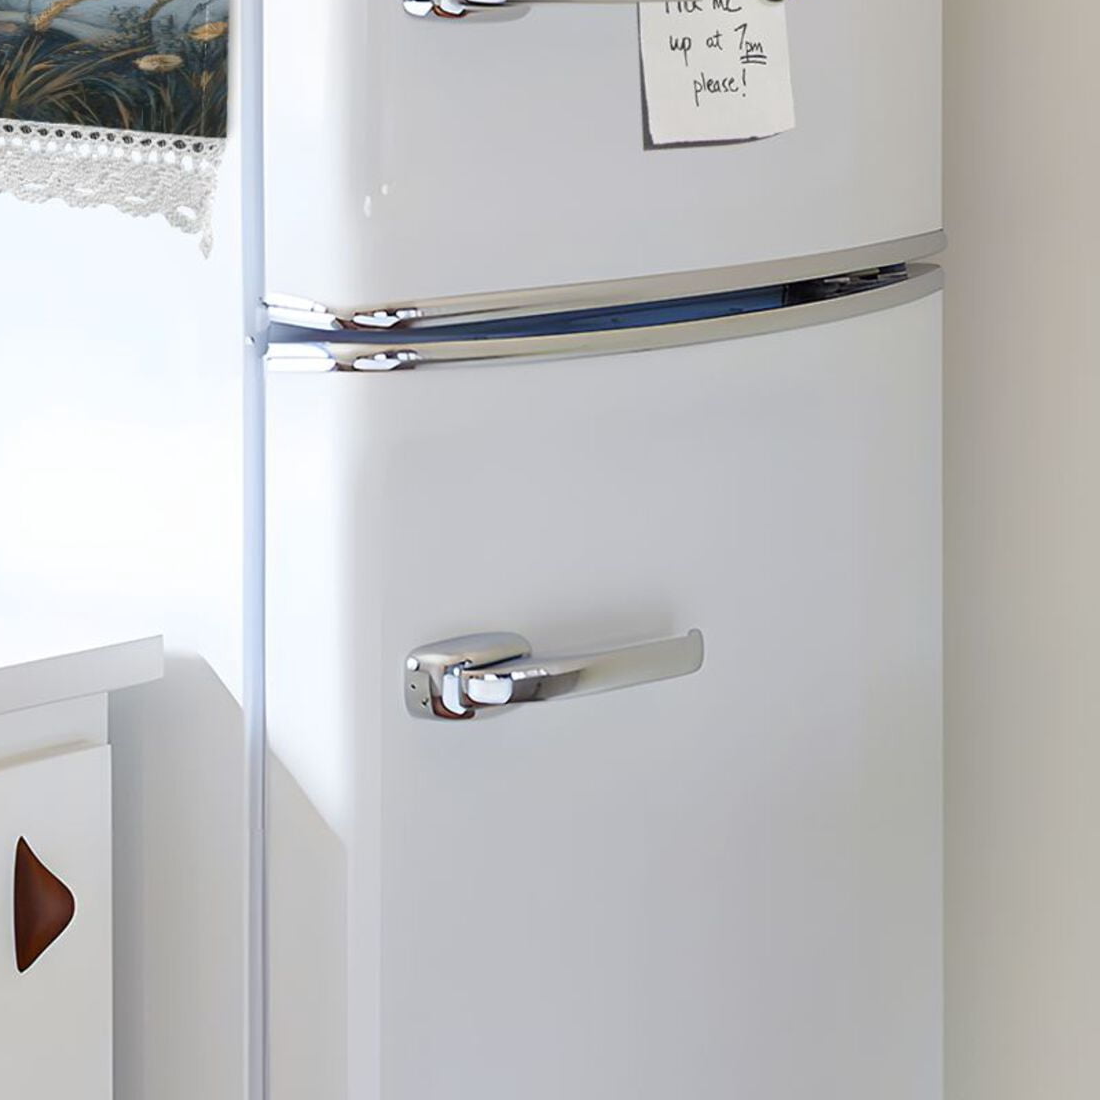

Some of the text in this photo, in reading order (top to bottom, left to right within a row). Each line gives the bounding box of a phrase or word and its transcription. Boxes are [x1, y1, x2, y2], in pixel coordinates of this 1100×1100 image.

[669, 36, 692, 66] up
[706, 30, 724, 51] at
[693, 68, 747, 107] please!
